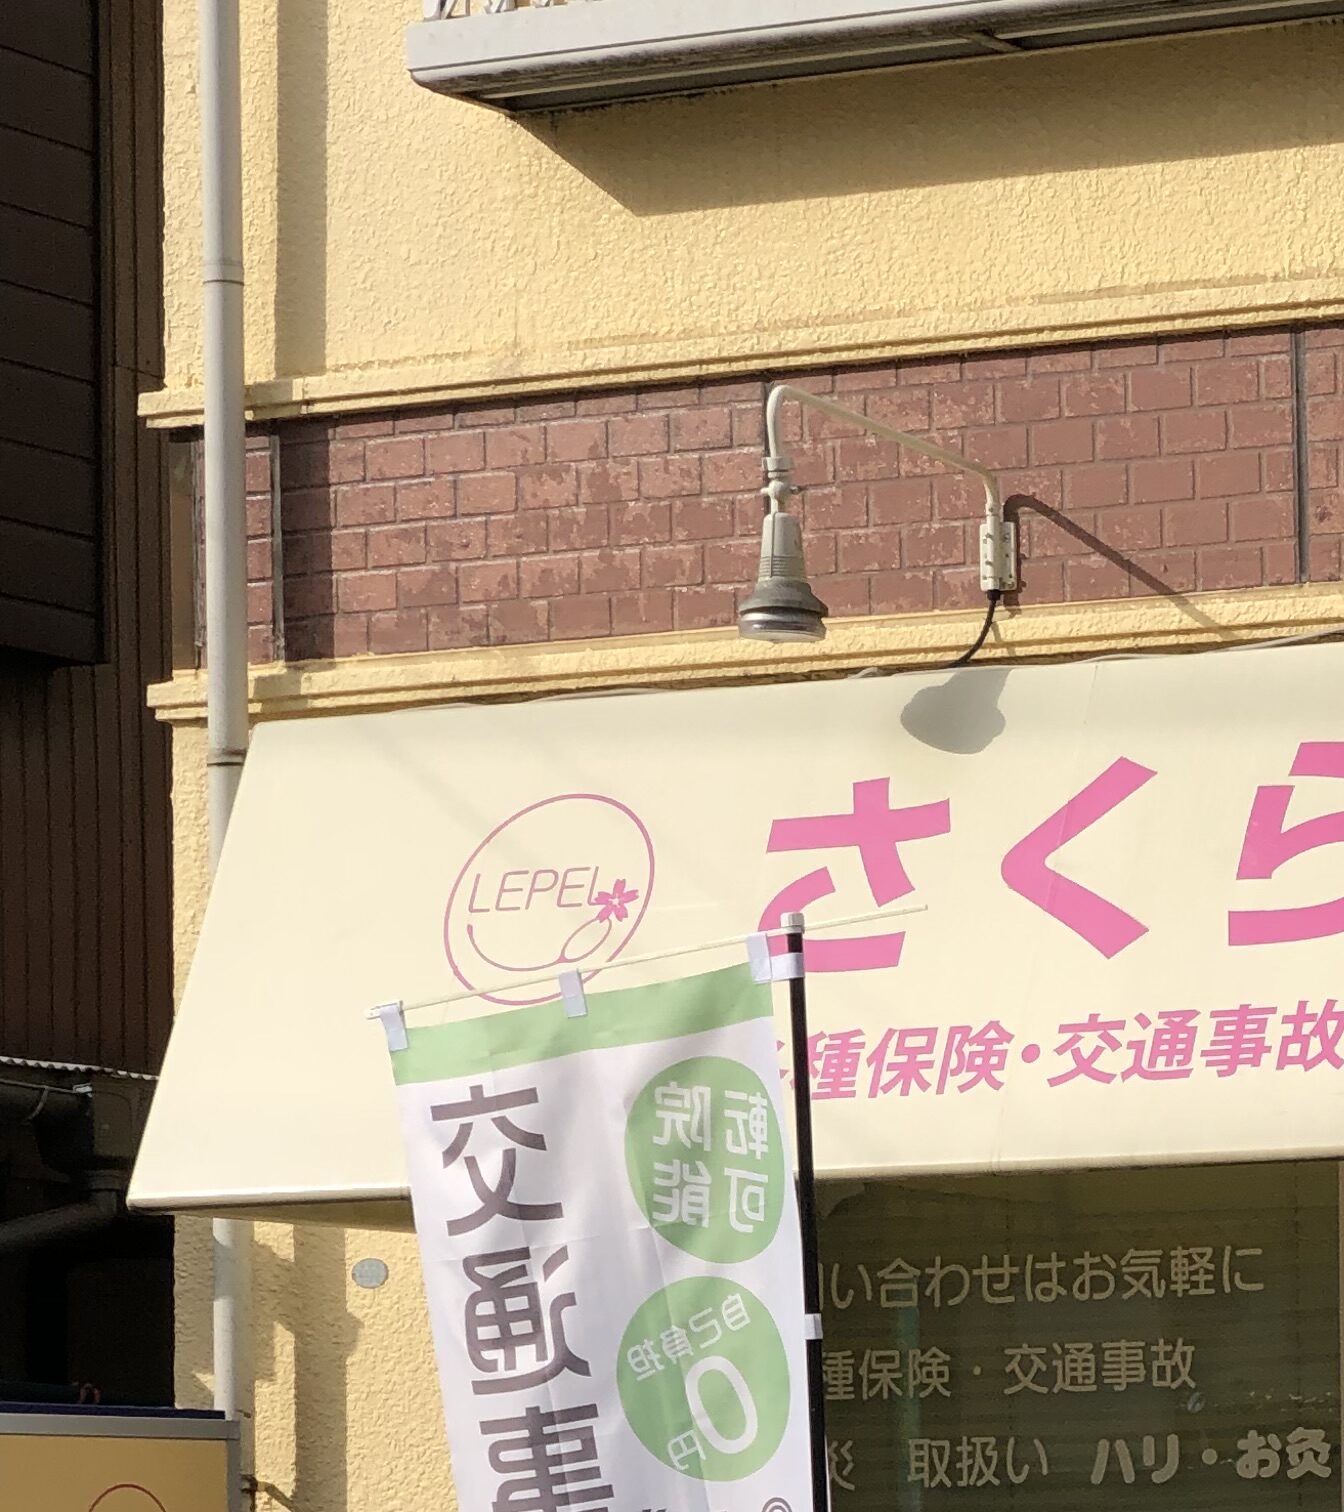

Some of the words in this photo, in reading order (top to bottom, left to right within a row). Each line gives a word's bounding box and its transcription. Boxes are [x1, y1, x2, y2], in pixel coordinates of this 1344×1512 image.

[819, 1245, 1265, 1311] い合わせはお気軽に
[907, 1435, 1050, 1490] 取扱い
